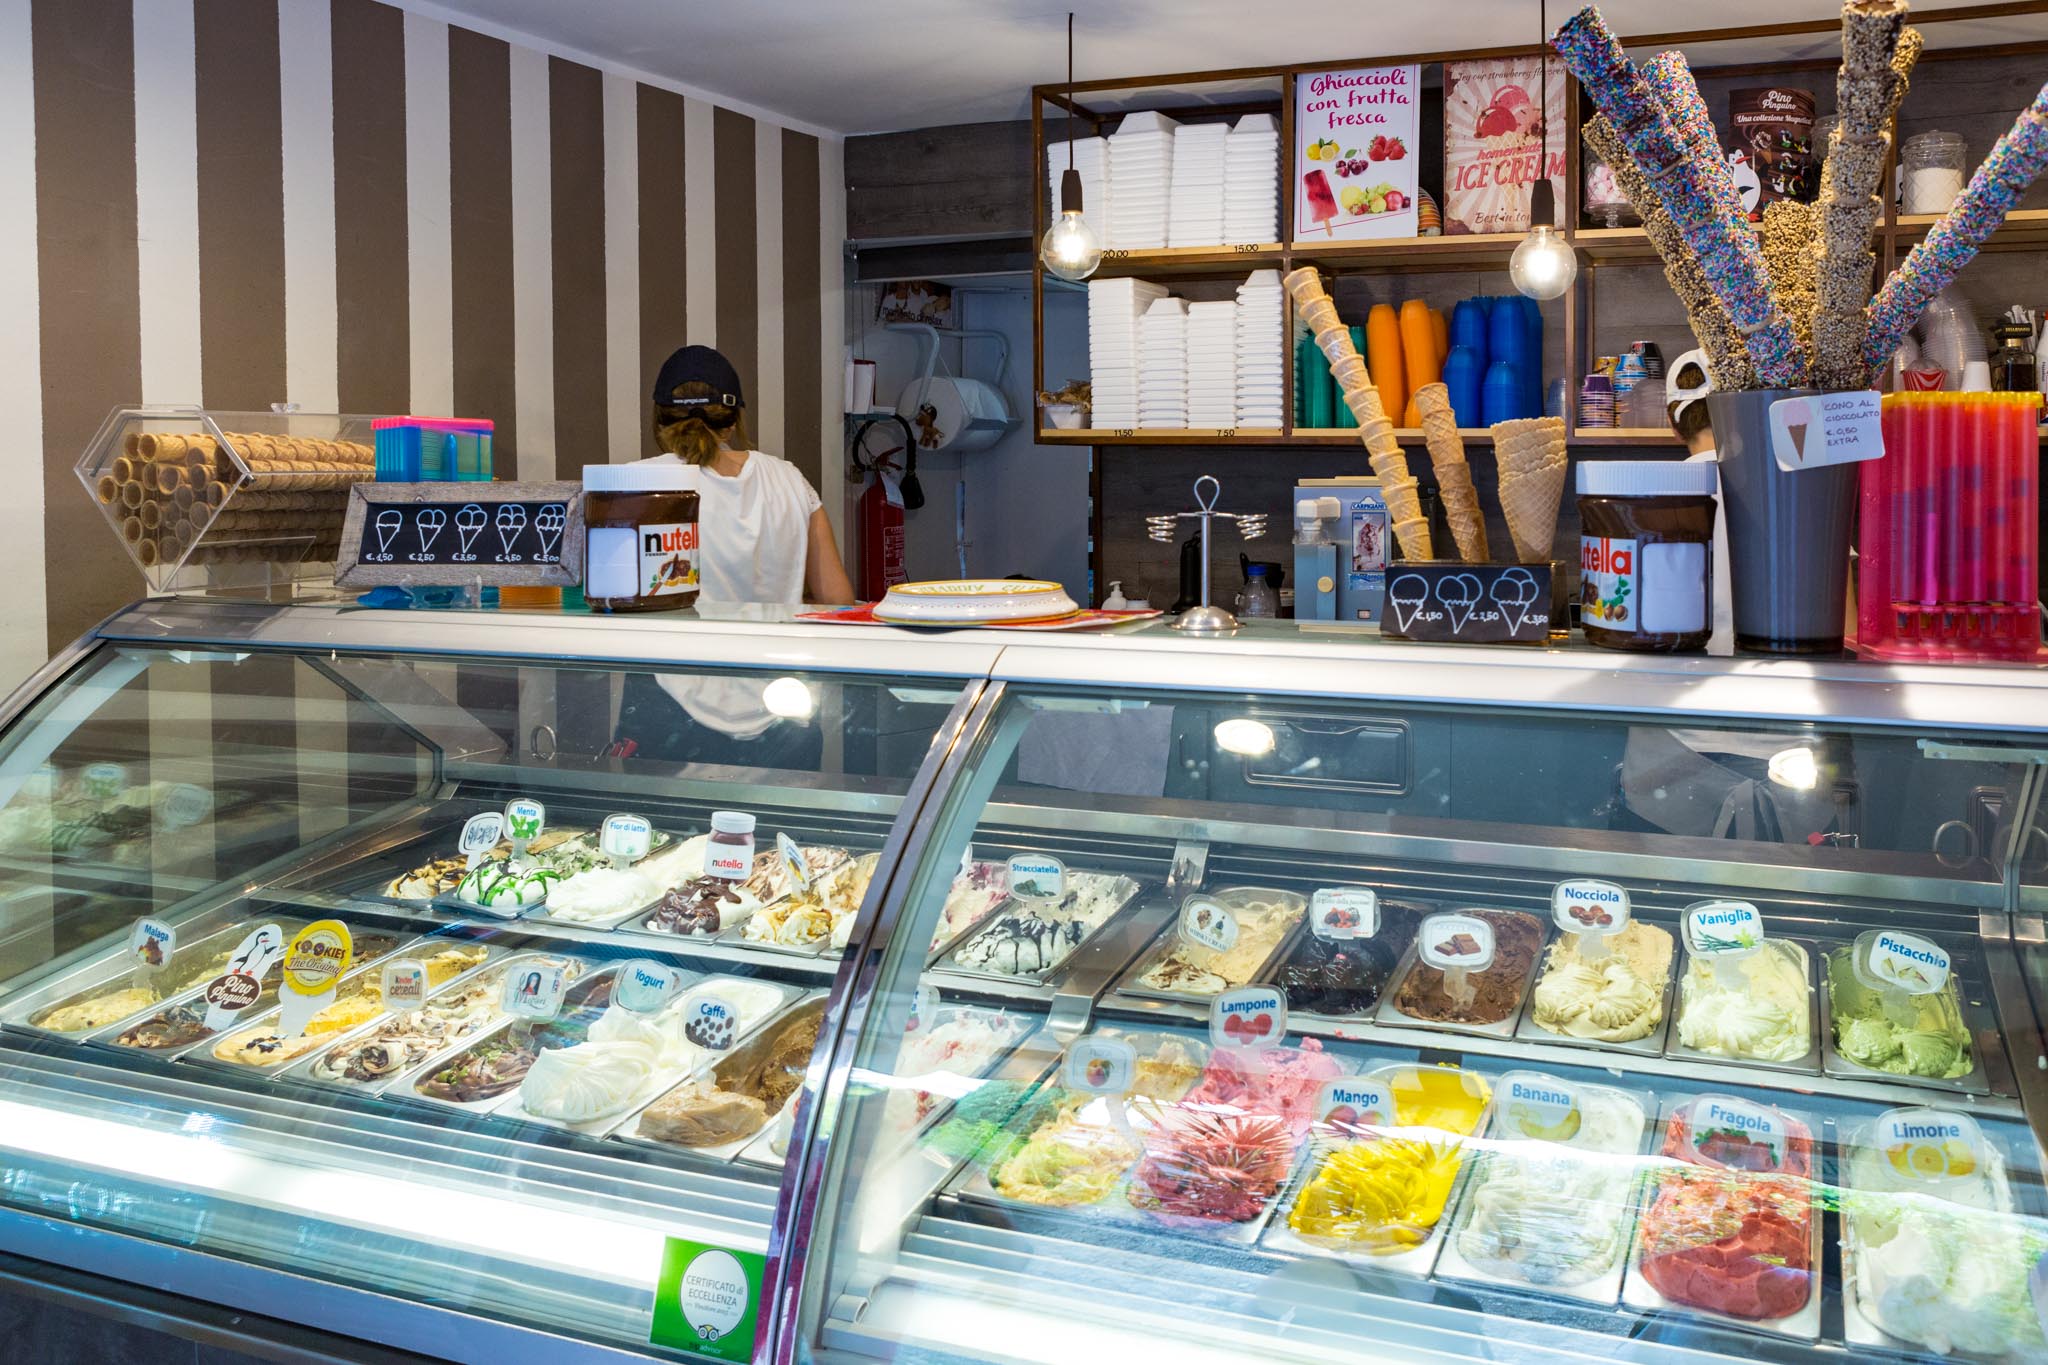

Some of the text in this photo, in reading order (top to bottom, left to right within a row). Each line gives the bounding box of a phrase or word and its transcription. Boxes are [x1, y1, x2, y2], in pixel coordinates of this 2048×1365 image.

[1310, 68, 1408, 96] Ghiaccioli
[1488, 69, 1532, 81] strawberry
[1306, 88, 1410, 113] con frutta
[1761, 98, 1797, 112] Pinguino
[1767, 90, 1793, 105] Pino
[1327, 111, 1388, 129] fresca
[1737, 114, 1752, 123] Una
[1752, 114, 1784, 122] collezione
[1476, 142, 1543, 161] homemade
[1454, 161, 1491, 192] ICE
[1474, 211, 1499, 225] Best
[1823, 399, 1875, 411] CONO AL
[1825, 410, 1880, 422] CIOCCOLATO
[1827, 435, 1860, 447] EXTRA
[645, 522, 700, 553] nutell
[1581, 537, 1633, 576] tella
[516, 806, 537, 817] Menta
[609, 821, 647, 833] Fior di latte
[712, 858, 744, 869] nutella
[1011, 863, 1060, 875] Stracciatella
[1564, 887, 1620, 903] Nocciola
[1696, 909, 1753, 926] Vaniglia
[144, 923, 169, 942] Malaga
[294, 940, 347, 960] COOKIES
[1879, 936, 1948, 969] Pistacchio
[286, 957, 306, 969] The
[306, 957, 346, 978] Original
[223, 975, 255, 995] Pino
[635, 968, 665, 990] Yogurt
[209, 985, 255, 1005] Pinguino
[699, 1003, 727, 1019] Caffè
[1221, 998, 1277, 1014] Lampone
[1332, 1089, 1380, 1108] Mango
[1512, 1083, 1571, 1105] Banana
[1710, 1104, 1772, 1133] Fragola
[1893, 1122, 1961, 1139] Limone
[686, 1275, 736, 1294] CERTIFICATO
[688, 1288, 738, 1307] ECCELLENZA
